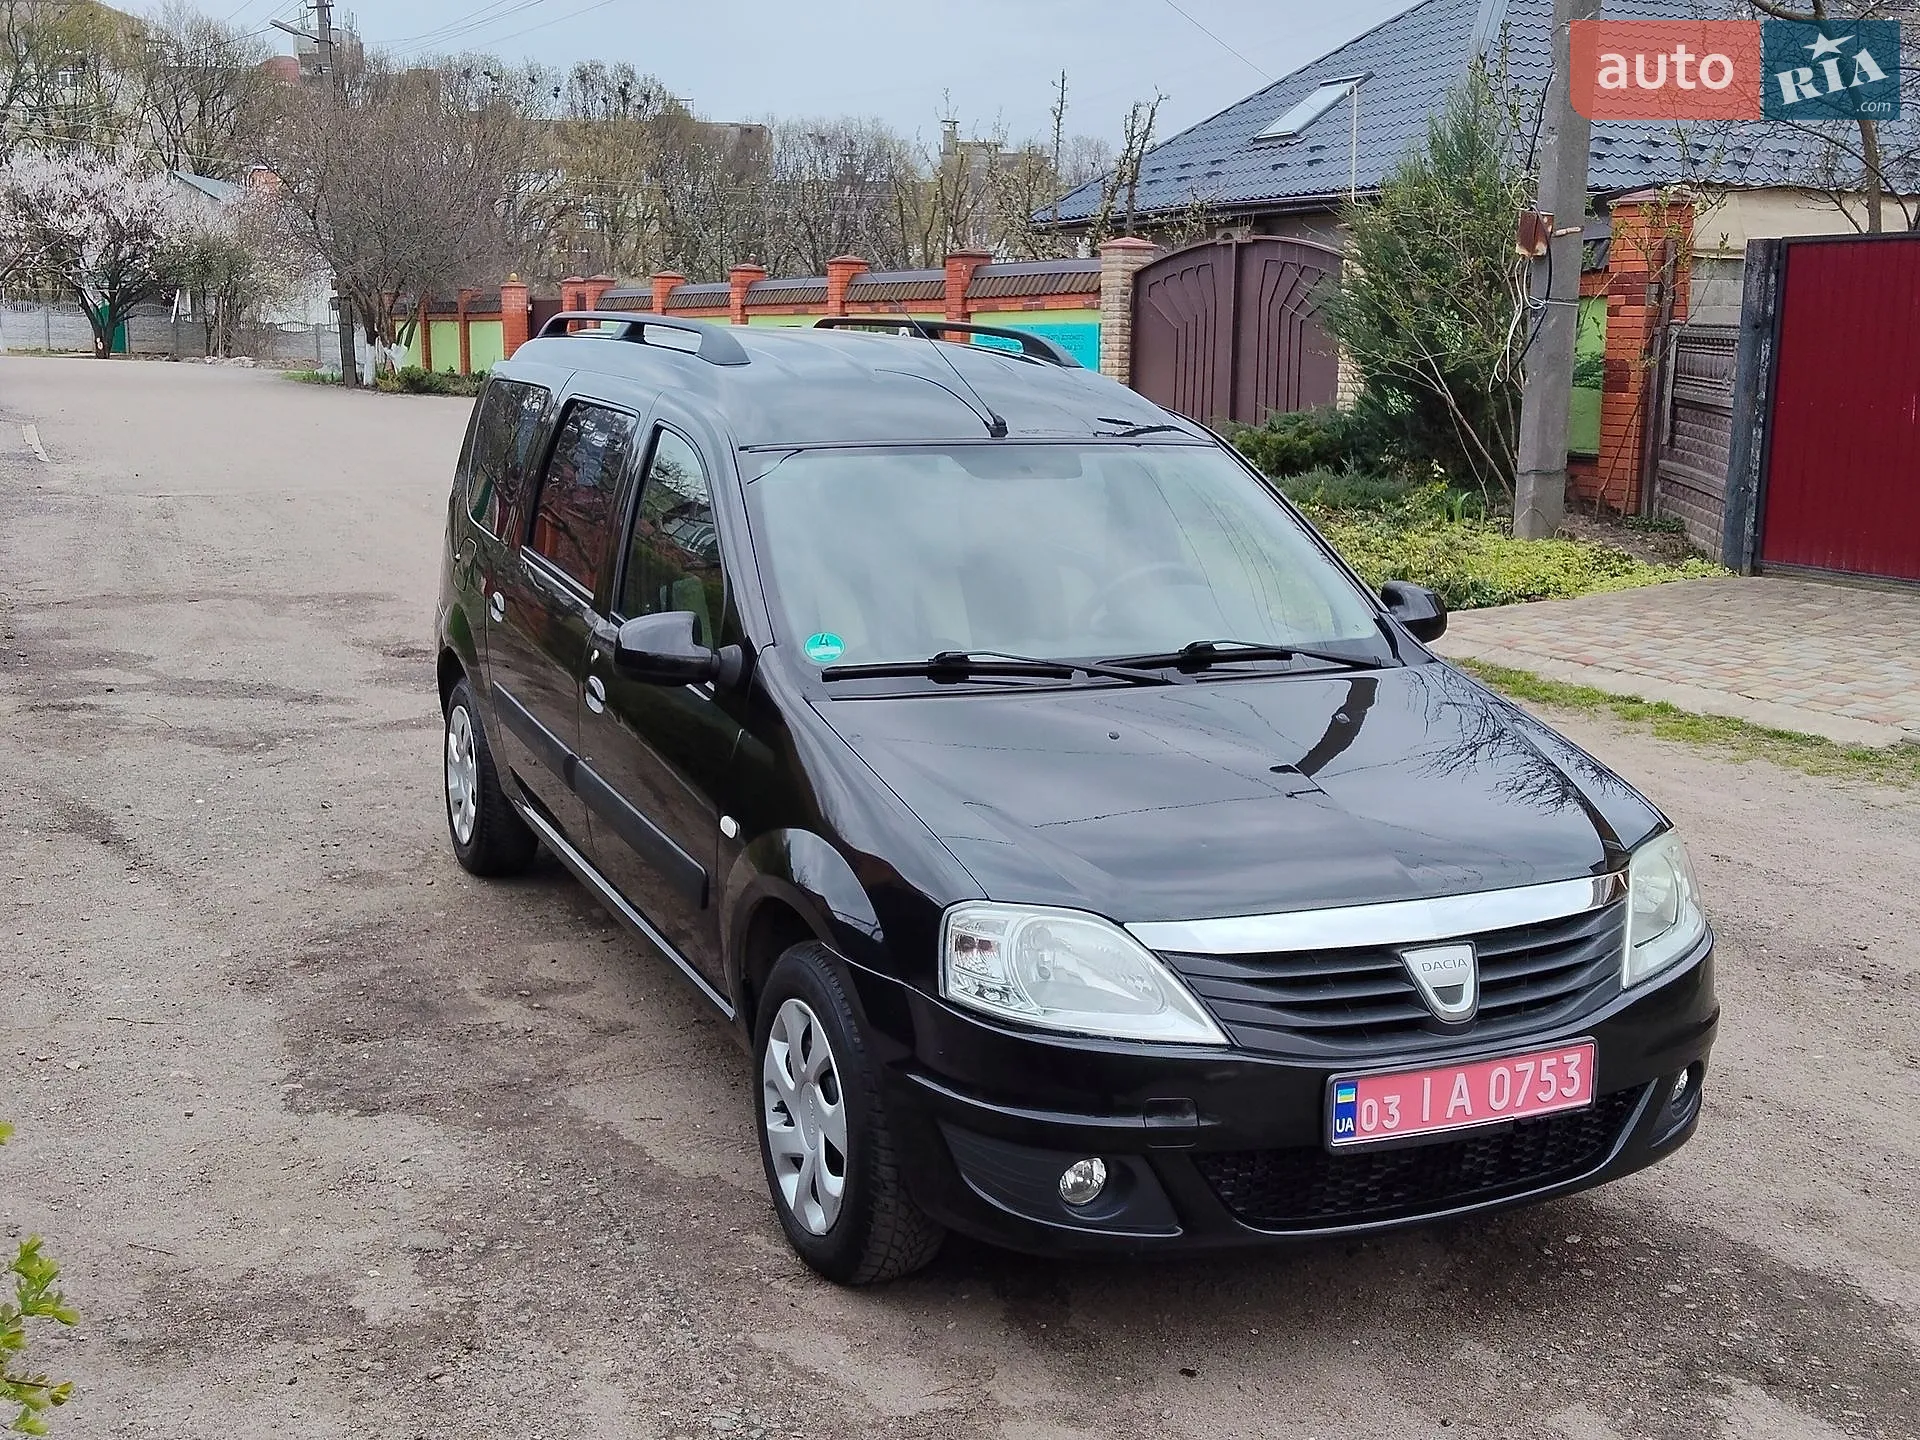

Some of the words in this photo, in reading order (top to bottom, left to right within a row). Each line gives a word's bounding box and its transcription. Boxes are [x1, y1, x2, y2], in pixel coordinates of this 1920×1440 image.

[819, 633, 829, 647] 4
[1421, 958, 1468, 972] DACIA
[1360, 1095, 1401, 1132] 03
[1489, 1053, 1582, 1111] 0753
[1336, 1117, 1355, 1133] UA
